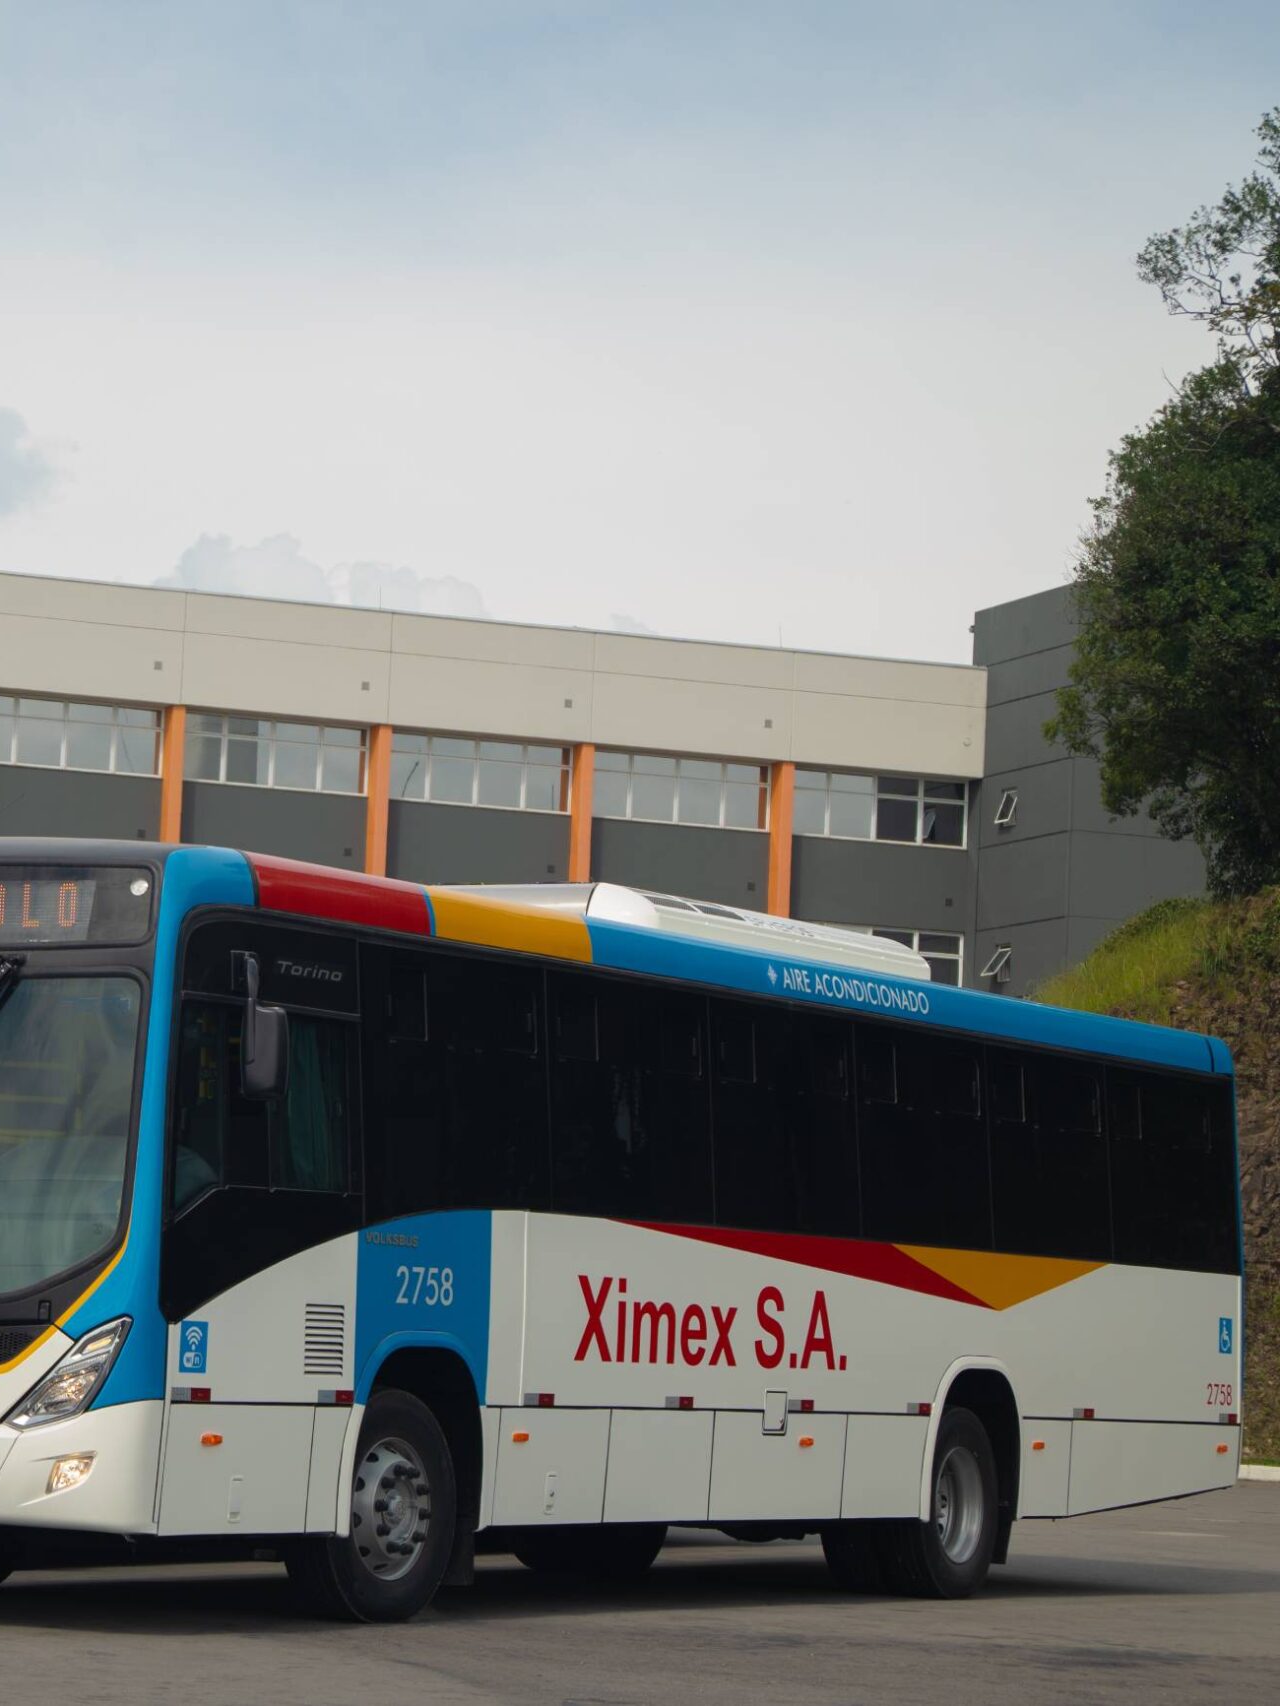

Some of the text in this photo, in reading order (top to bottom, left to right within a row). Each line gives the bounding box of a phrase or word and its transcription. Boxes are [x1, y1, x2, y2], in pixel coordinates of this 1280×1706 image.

[277, 960, 343, 982] Torino
[783, 967, 930, 1015] AIRE ACONDICIONADO
[395, 1264, 454, 1306] 2758
[573, 1275, 848, 1371] Ximex S.A.
[1206, 1383, 1233, 1407] 2758
